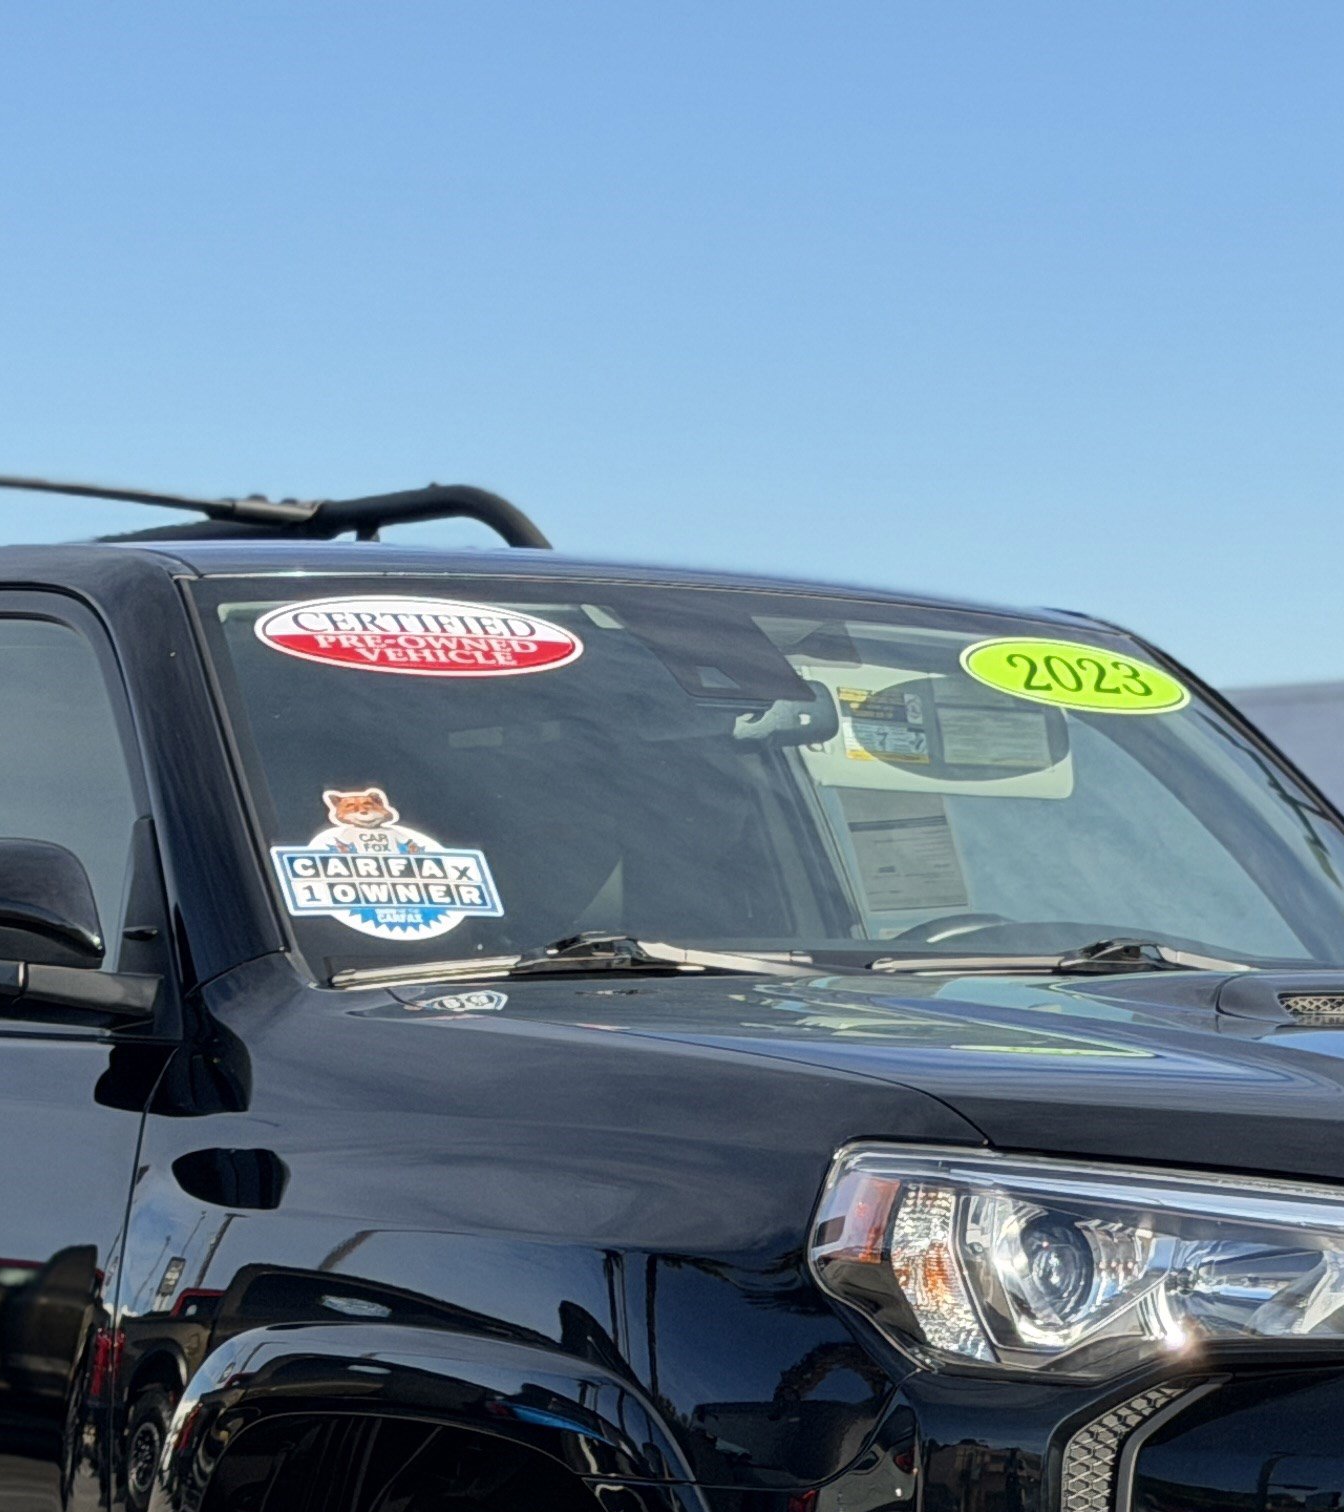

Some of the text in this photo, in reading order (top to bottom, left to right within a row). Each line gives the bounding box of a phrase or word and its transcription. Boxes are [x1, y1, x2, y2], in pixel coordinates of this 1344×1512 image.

[292, 611, 536, 638] CERTIFIED
[312, 633, 538, 654] PRE-OWNED
[354, 647, 518, 667] VEHICLE
[1006, 653, 1153, 697] 2023
[358, 833, 389, 846] CAR
[363, 843, 392, 852] FOX
[293, 856, 475, 881] CARFAX
[301, 884, 483, 905] 1 OWNER
